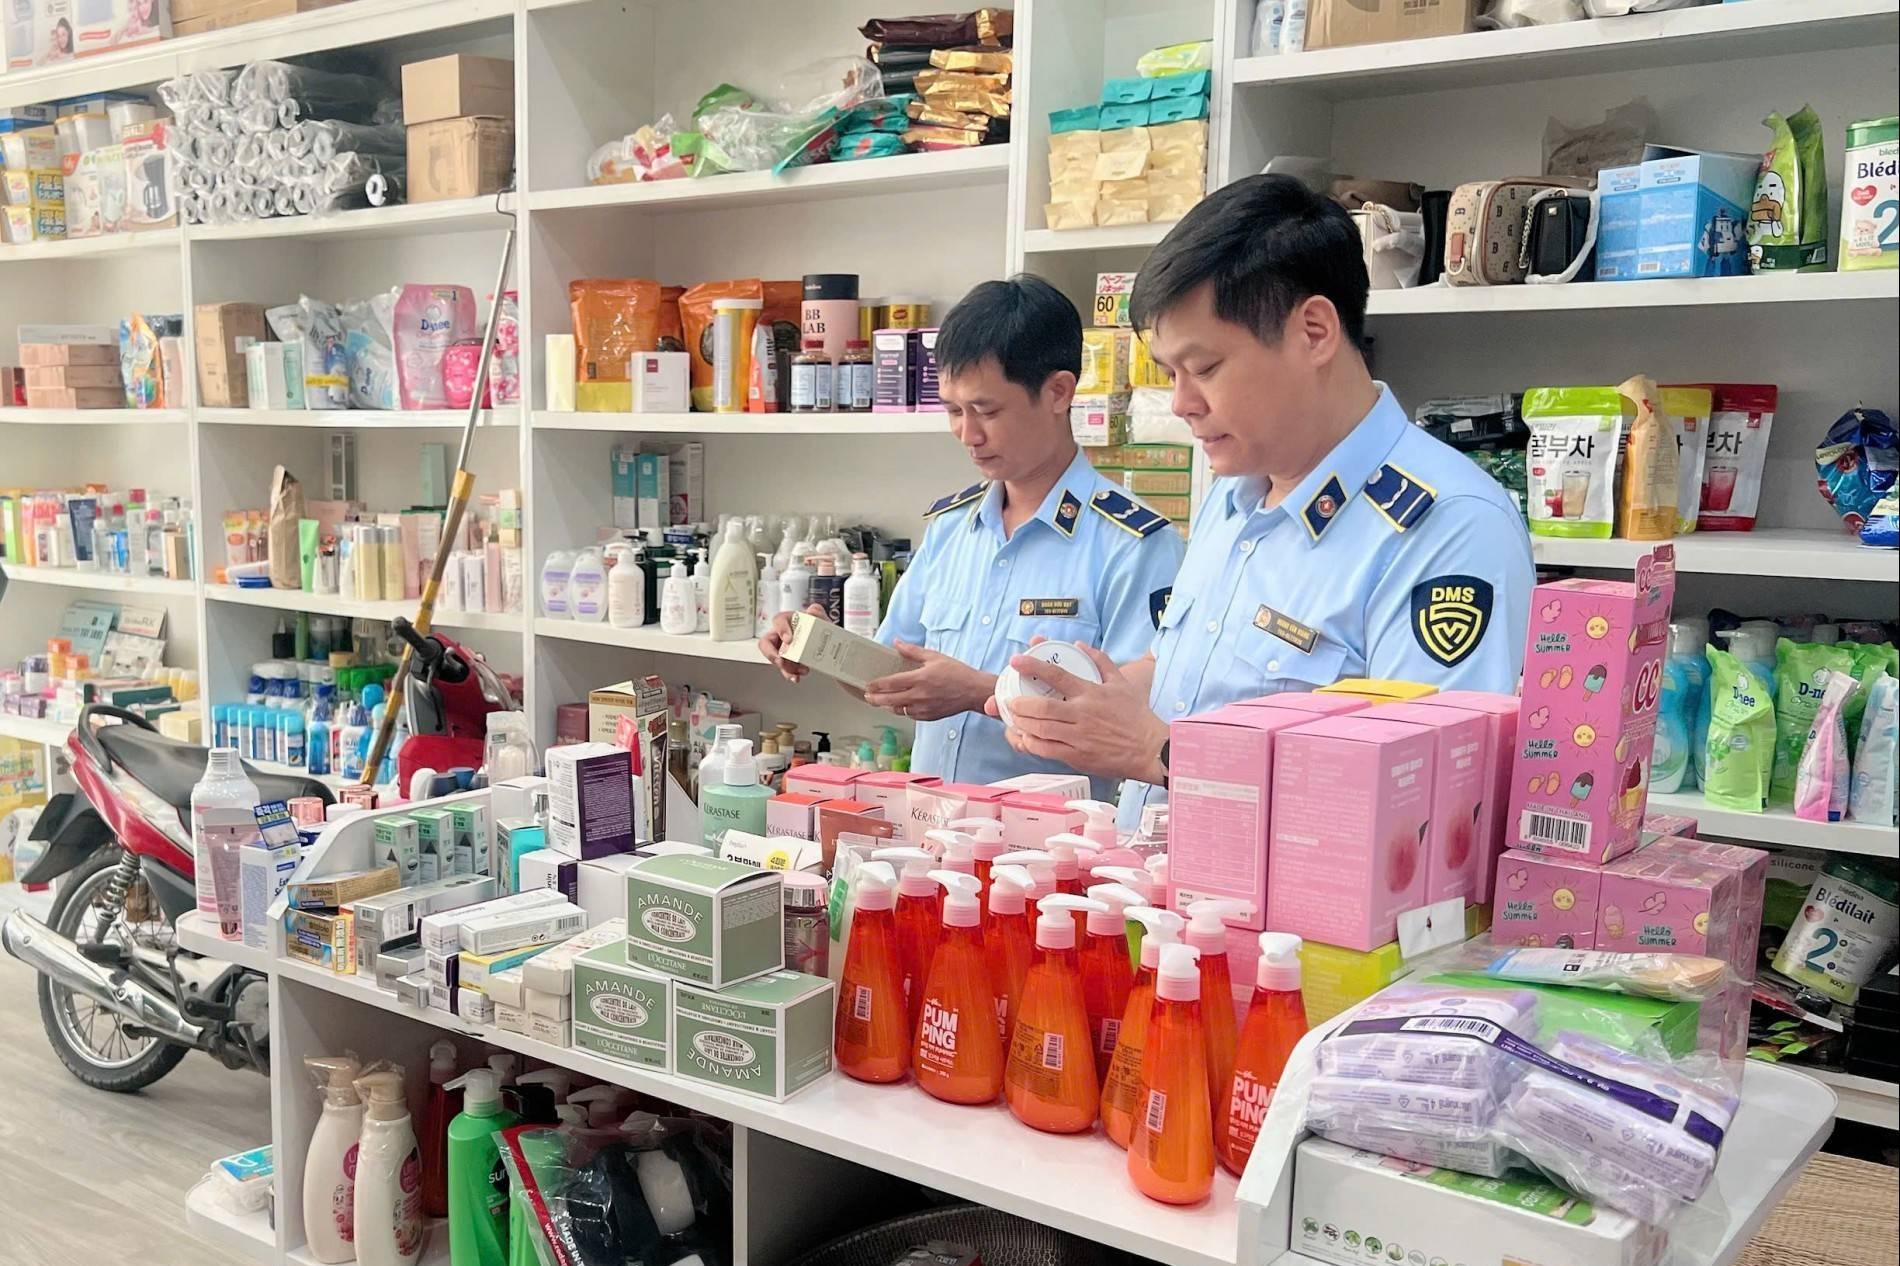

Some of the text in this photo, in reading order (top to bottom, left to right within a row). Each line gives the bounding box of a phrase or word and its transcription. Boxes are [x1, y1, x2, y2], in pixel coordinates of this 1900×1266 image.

[1857, 160, 1899, 179] Bléd
[1097, 295, 1114, 313] 60
[805, 309, 820, 320] BB
[803, 322, 825, 334] LAB
[1431, 587, 1475, 603] DMS
[1540, 633, 1567, 643] Hello
[1633, 658, 1661, 714] CC
[1528, 739, 1554, 749] Hello
[1770, 858, 1815, 871] silicone
[638, 893, 704, 925] AMANDE
[1507, 901, 1533, 911] Hello
[1815, 887, 1875, 925] Blédilait
[1643, 925, 1672, 935] Hello
[1805, 927, 1839, 974] 2
[584, 980, 656, 1010] AMANDE
[923, 1003, 959, 1033] PUM
[921, 1021, 956, 1050] PING
[686, 1047, 761, 1080] AMANDE
[560, 1222, 577, 1251] MADE
